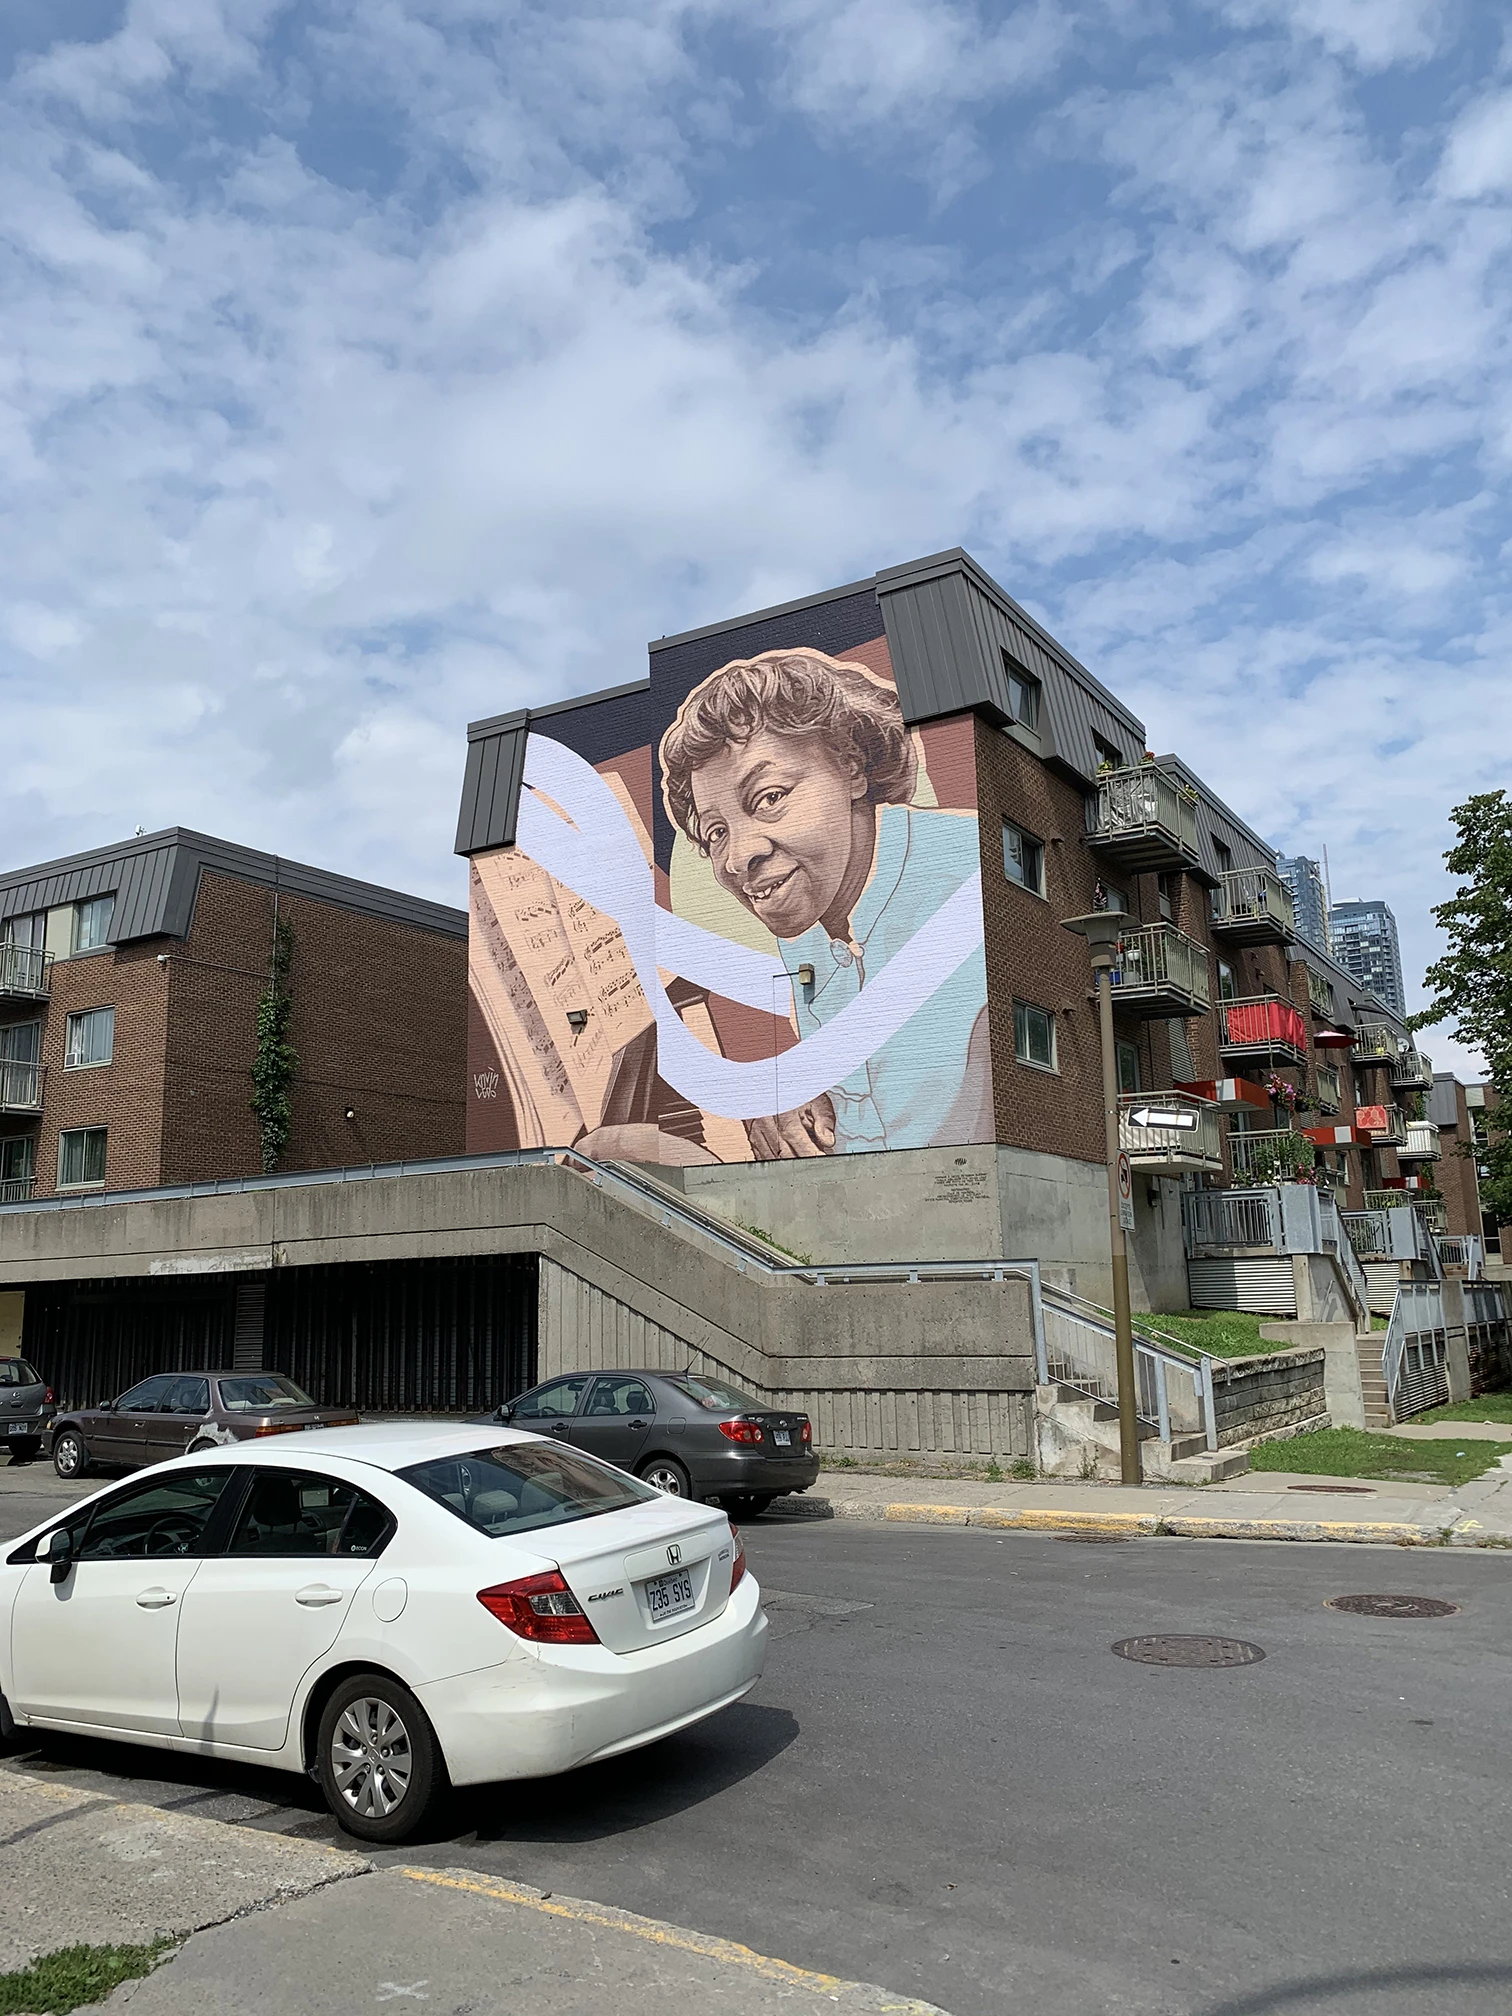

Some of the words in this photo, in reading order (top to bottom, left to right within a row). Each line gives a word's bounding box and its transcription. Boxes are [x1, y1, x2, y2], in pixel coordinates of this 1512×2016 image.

[587, 1587, 624, 1602] CIVIC
[649, 1587, 670, 1611] Z35
[672, 1579, 692, 1602] SYS
